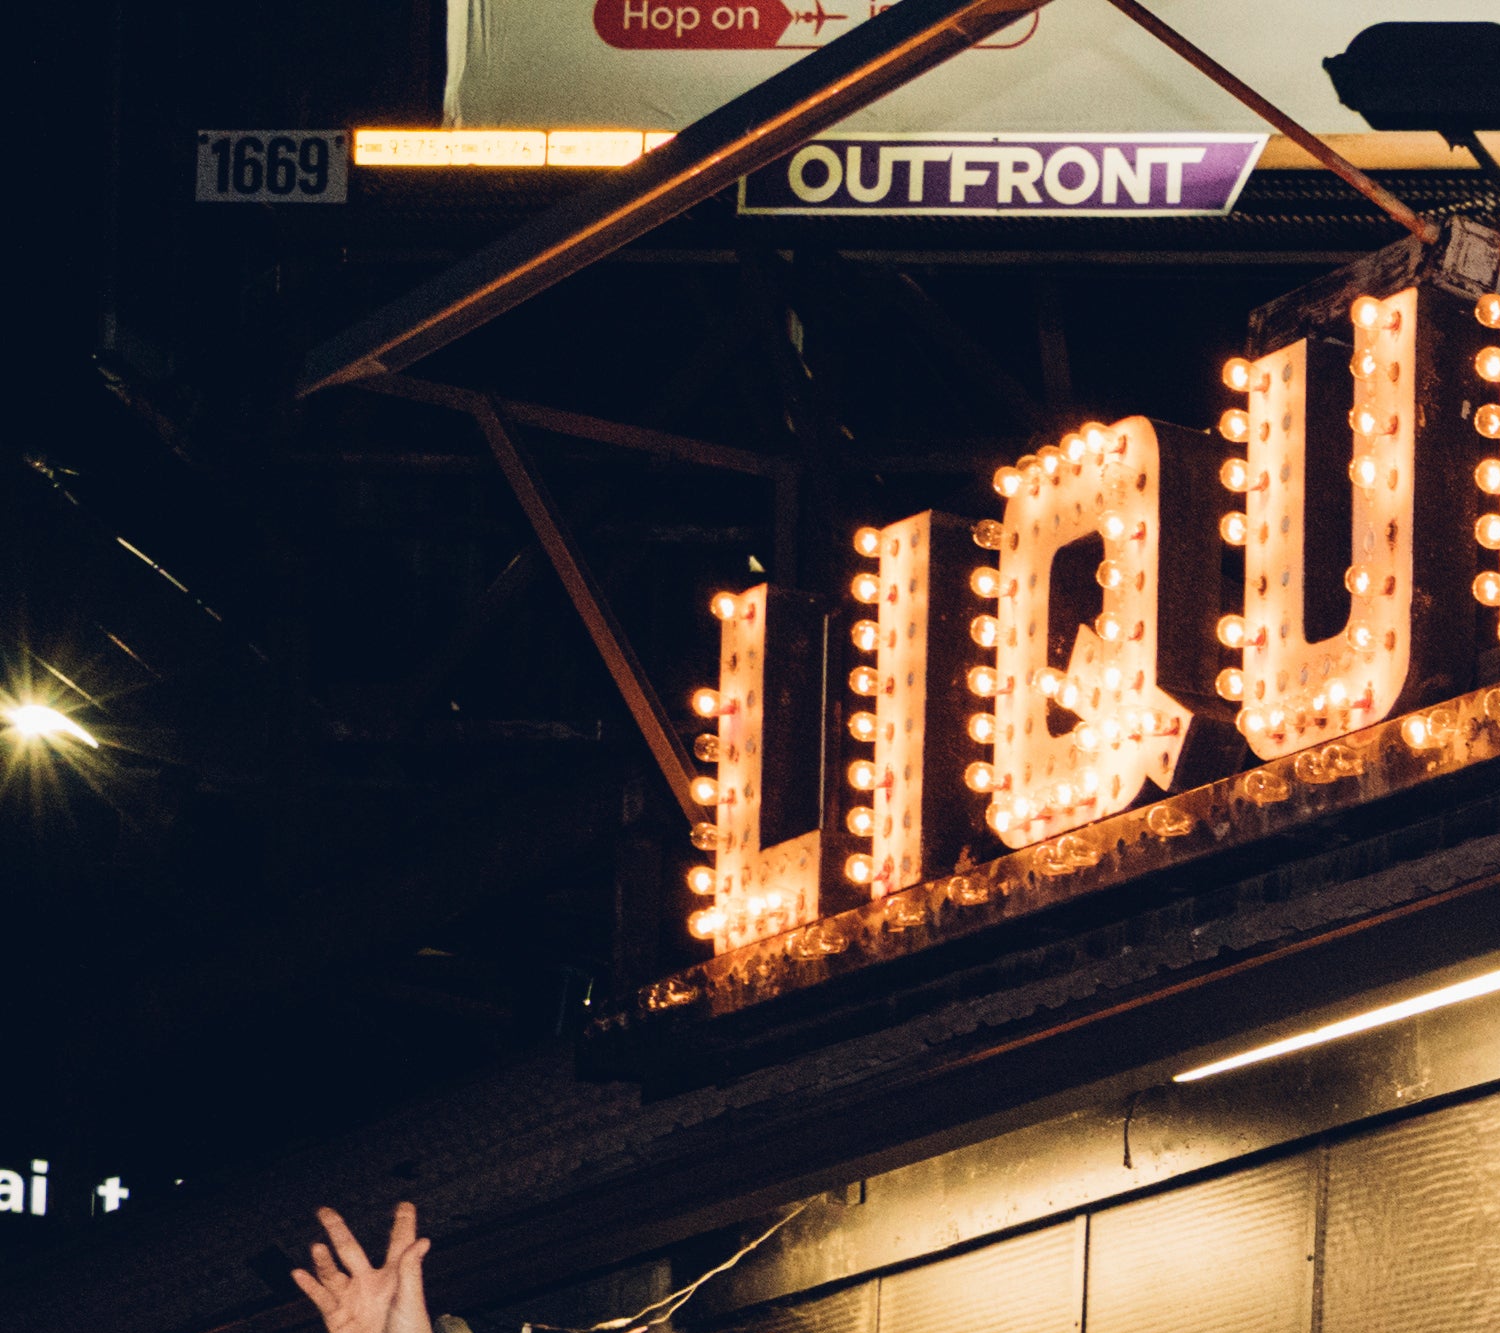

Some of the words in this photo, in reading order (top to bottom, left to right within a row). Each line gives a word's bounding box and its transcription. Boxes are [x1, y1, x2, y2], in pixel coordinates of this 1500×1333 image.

[622, 0, 699, 38] Hop
[712, 6, 760, 31] on
[210, 136, 329, 195] 1669
[788, 145, 1206, 204] OUTFRONT
